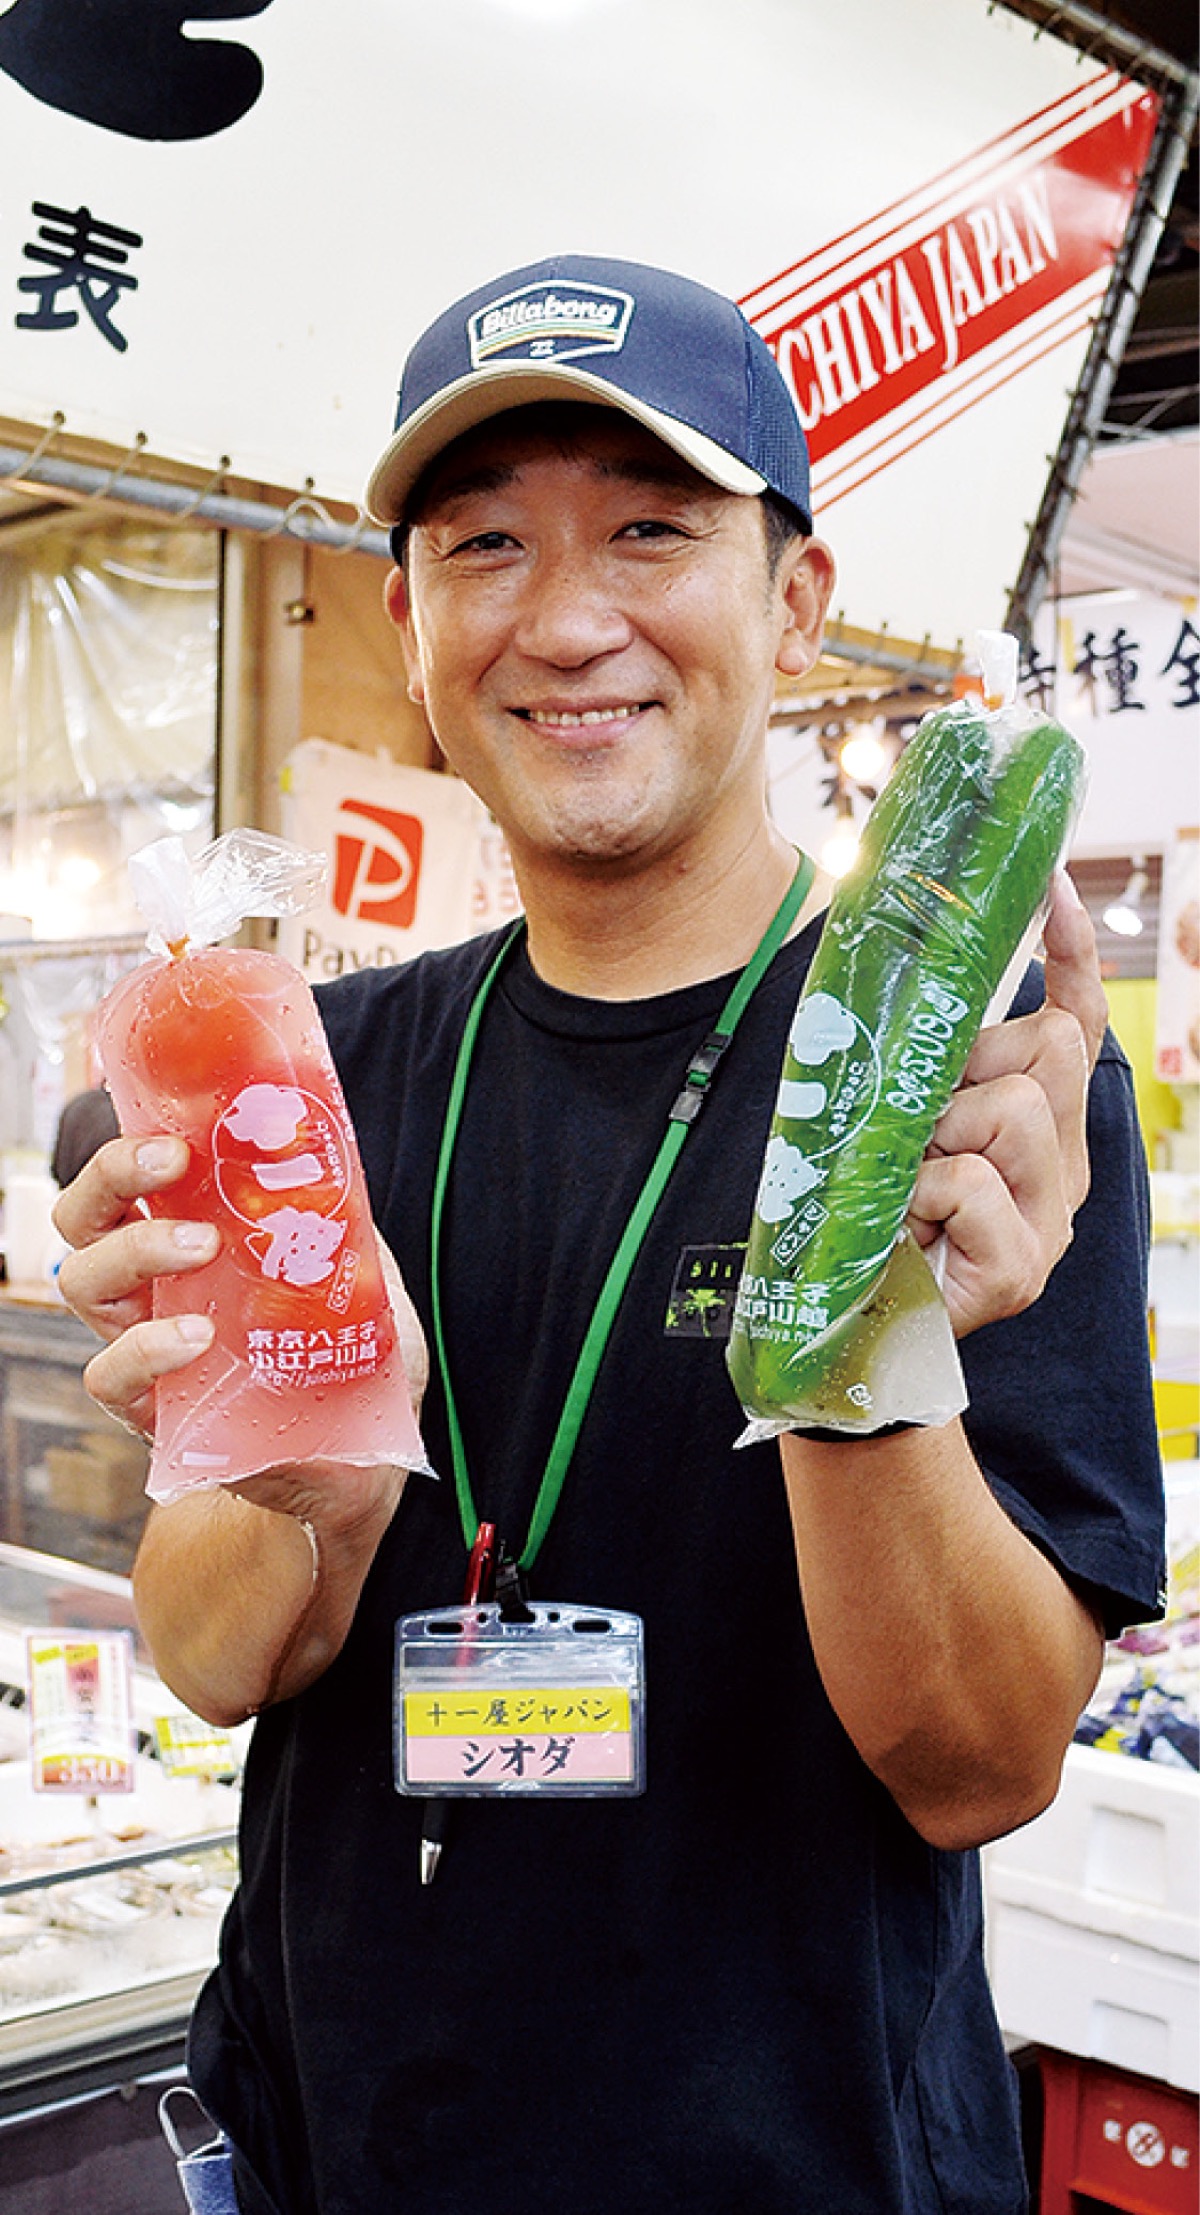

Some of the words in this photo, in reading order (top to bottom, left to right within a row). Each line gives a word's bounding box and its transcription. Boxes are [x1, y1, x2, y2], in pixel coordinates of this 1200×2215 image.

[15, 201, 143, 352] 表
[482, 295, 618, 338] Billabong
[766, 257, 937, 431] CHIYA
[919, 172, 1060, 373] JAPAN
[426, 1699, 612, 1727] 十一屋ジャパン
[461, 1736, 576, 1778] シオダ
